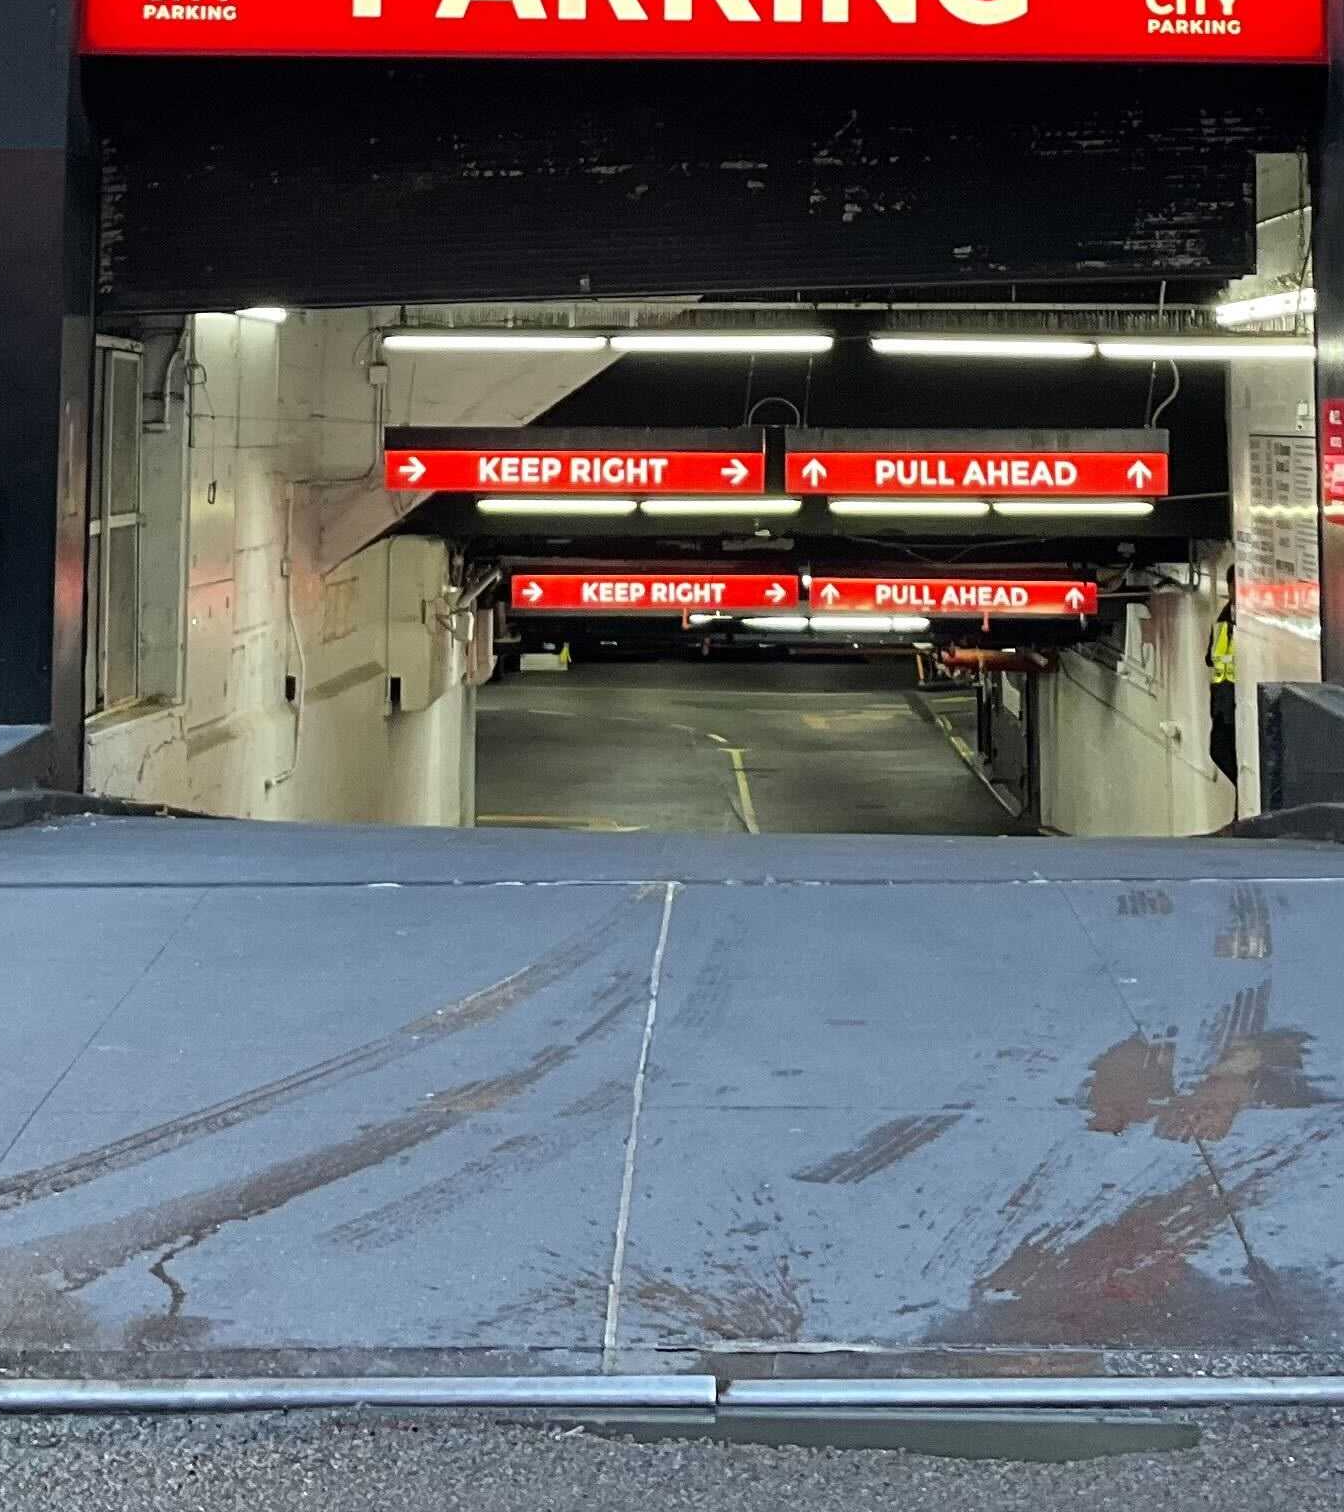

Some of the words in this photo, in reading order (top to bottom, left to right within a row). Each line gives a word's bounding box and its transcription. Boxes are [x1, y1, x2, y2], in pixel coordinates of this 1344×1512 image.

[143, 4, 237, 21] PARKING
[1147, 19, 1241, 35] PARKING
[479, 457, 562, 484] KEEP
[570, 457, 669, 484] RIGHT
[875, 459, 955, 486] PULL
[962, 460, 1078, 487] AHEAD
[582, 582, 646, 604] KEEP
[651, 582, 726, 604] RIGHT
[875, 584, 937, 607] PULL
[941, 585, 1029, 609] AHEAD
